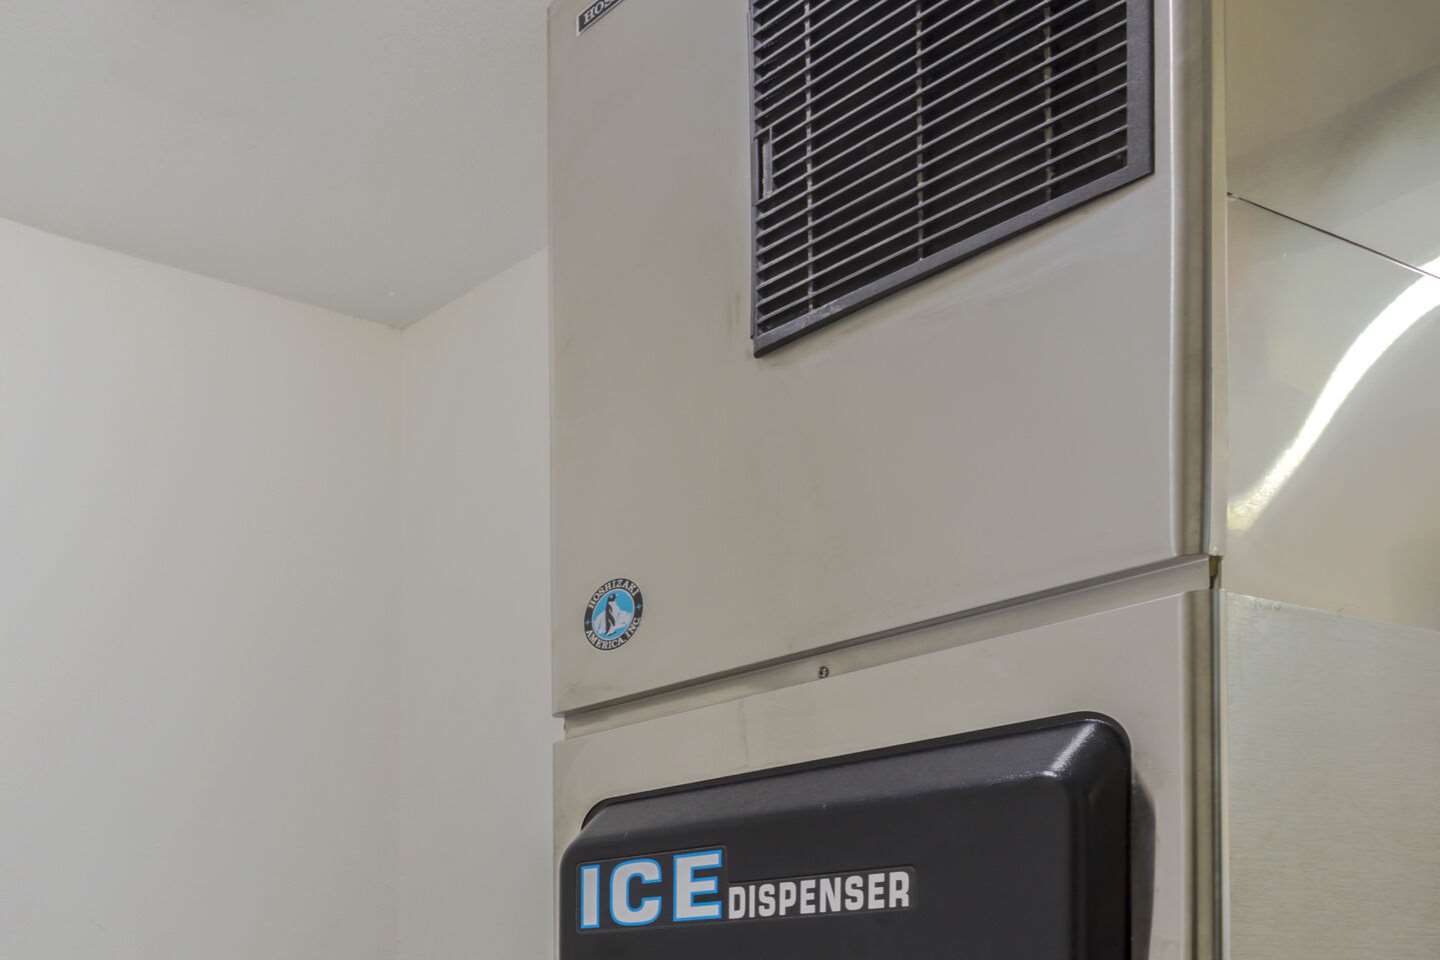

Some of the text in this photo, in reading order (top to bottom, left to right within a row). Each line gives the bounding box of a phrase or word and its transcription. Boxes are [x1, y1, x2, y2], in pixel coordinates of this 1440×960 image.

[588, 579, 640, 608] HOSHIZAKI
[580, 849, 910, 929] ICE DISPENSER
